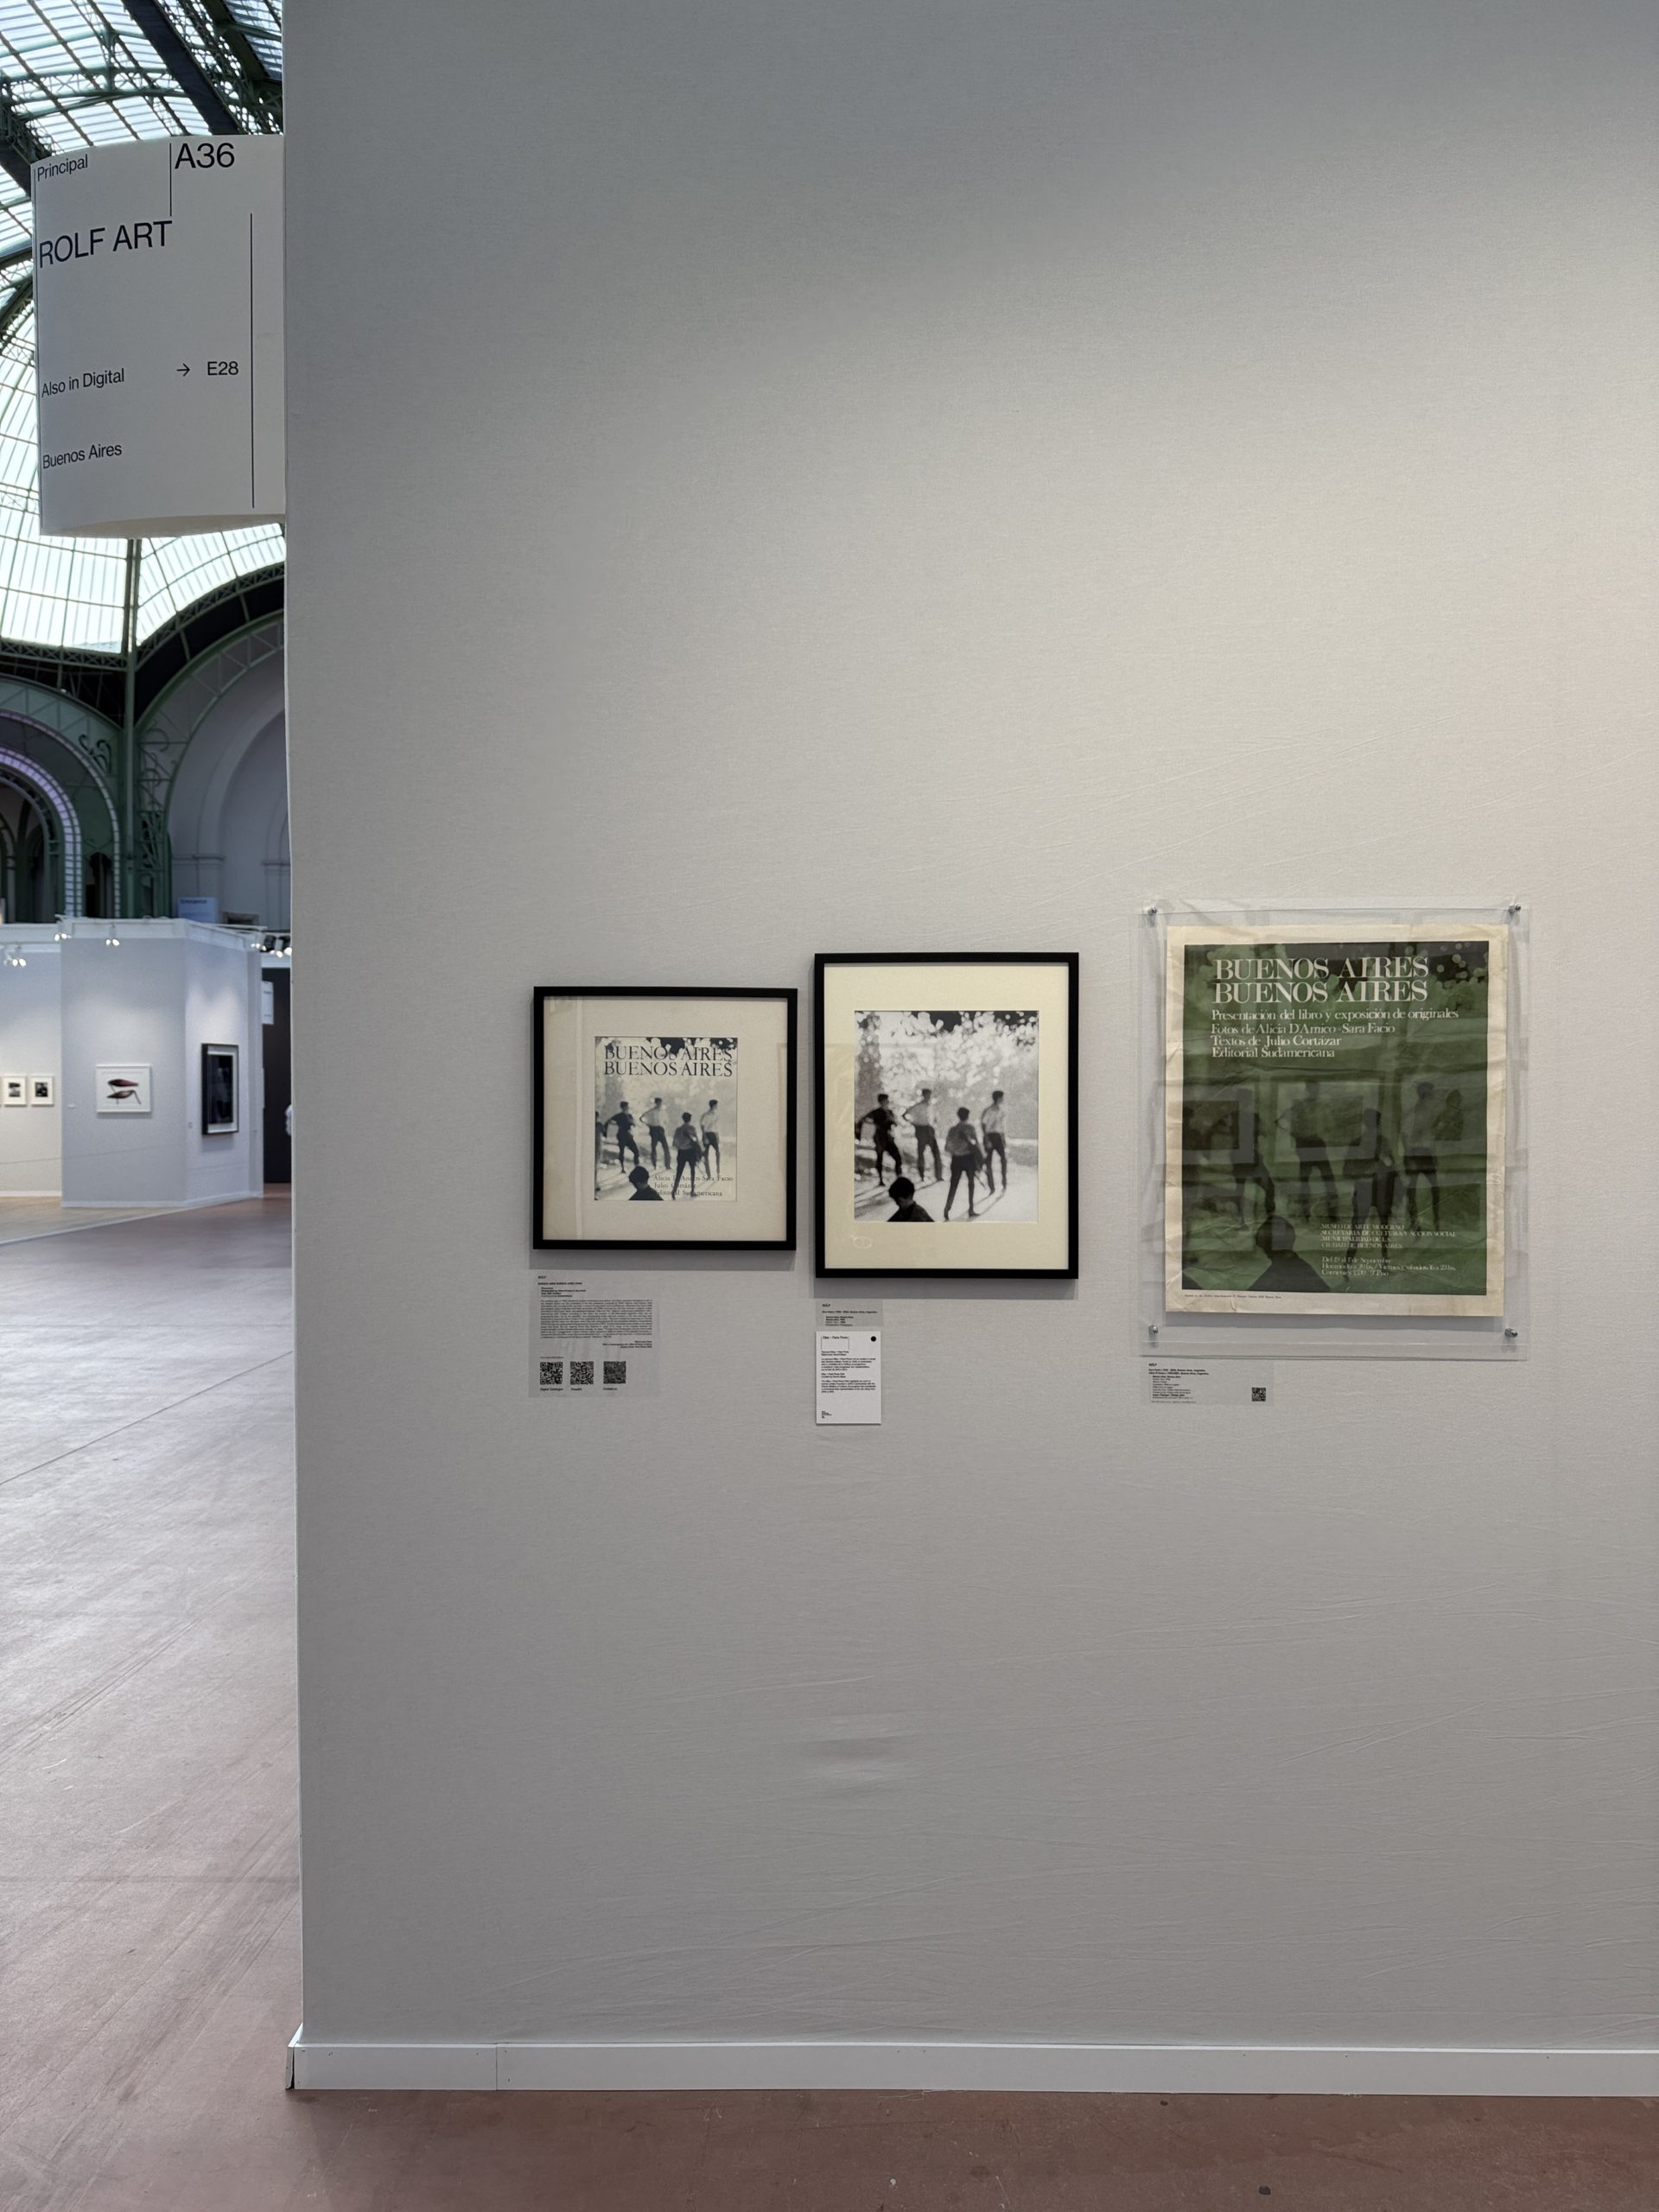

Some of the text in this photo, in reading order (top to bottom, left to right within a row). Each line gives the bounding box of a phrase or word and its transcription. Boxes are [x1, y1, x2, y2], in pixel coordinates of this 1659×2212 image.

[175, 142, 235, 169] A36
[37, 153, 88, 181] Principal
[39, 219, 173, 269] ROLF ART
[207, 360, 239, 376] E28
[41, 367, 124, 398] Also in Digital
[42, 443, 122, 469] Buenos Aires
[1212, 955, 1428, 980] BUENOS AIRES
[1211, 979, 1427, 1003] BUENOS AIRES
[1211, 1007, 1459, 1022] Presentación del libro y exposición de originales
[1211, 1023, 1239, 1034] Fotos
[1241, 1023, 1255, 1033] de
[1256, 1023, 1287, 1033] Alicia
[1342, 1022, 1366, 1033] Sara
[1367, 1022, 1395, 1033] Facio
[1210, 1034, 1342, 1047] Textos de Julio Cortázar
[680, 1046, 734, 1062] AIRES
[1211, 1046, 1335, 1058] Editorial Sudamericana
[603, 1061, 733, 1077] BUENOS AIRES
